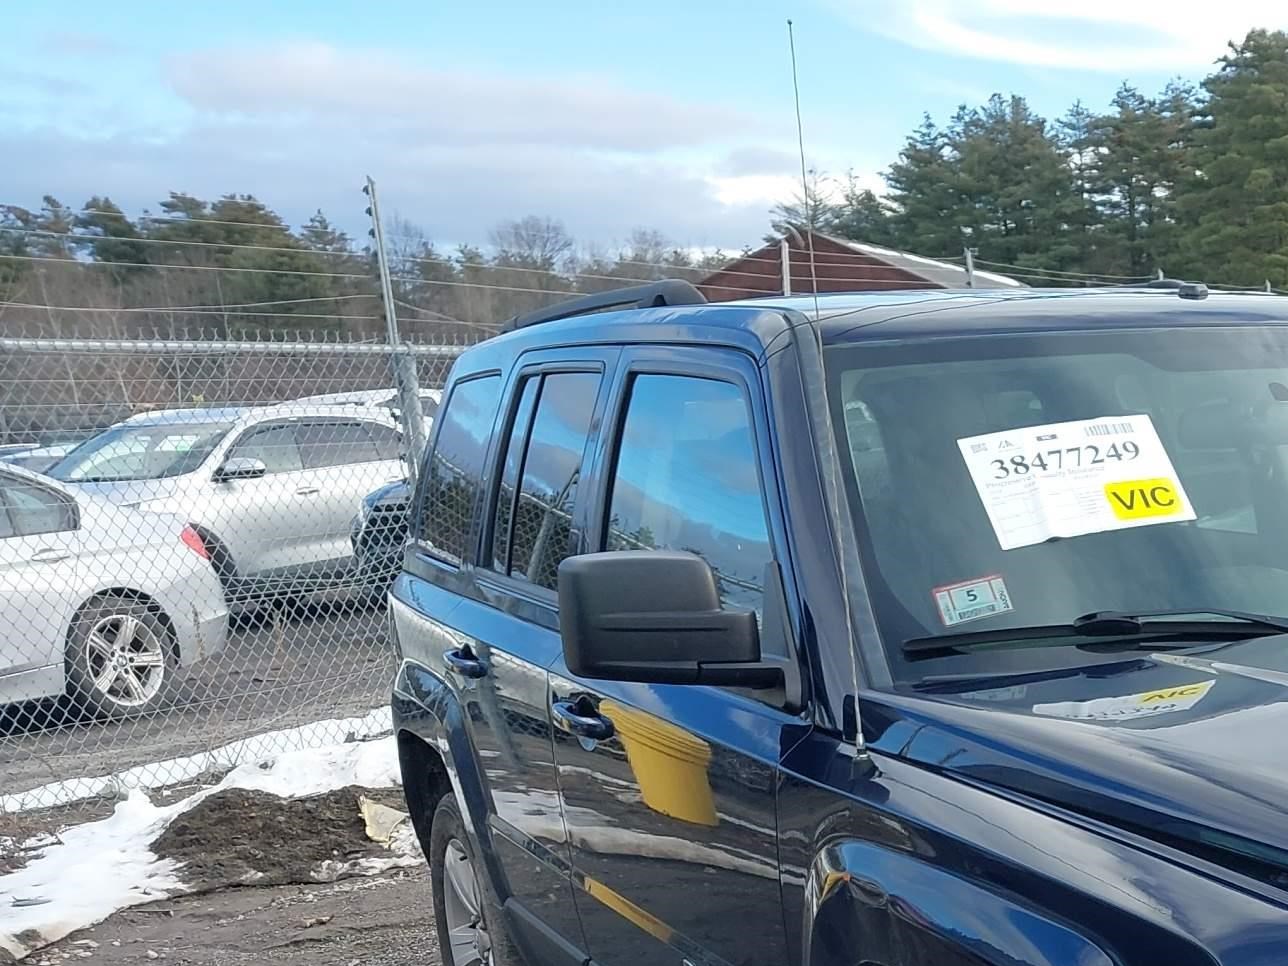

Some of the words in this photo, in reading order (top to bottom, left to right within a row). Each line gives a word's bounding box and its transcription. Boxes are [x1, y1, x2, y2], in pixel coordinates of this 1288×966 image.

[990, 440, 1141, 480] 38477249
[1111, 486, 1175, 512] VIC
[966, 589, 978, 602] 5
